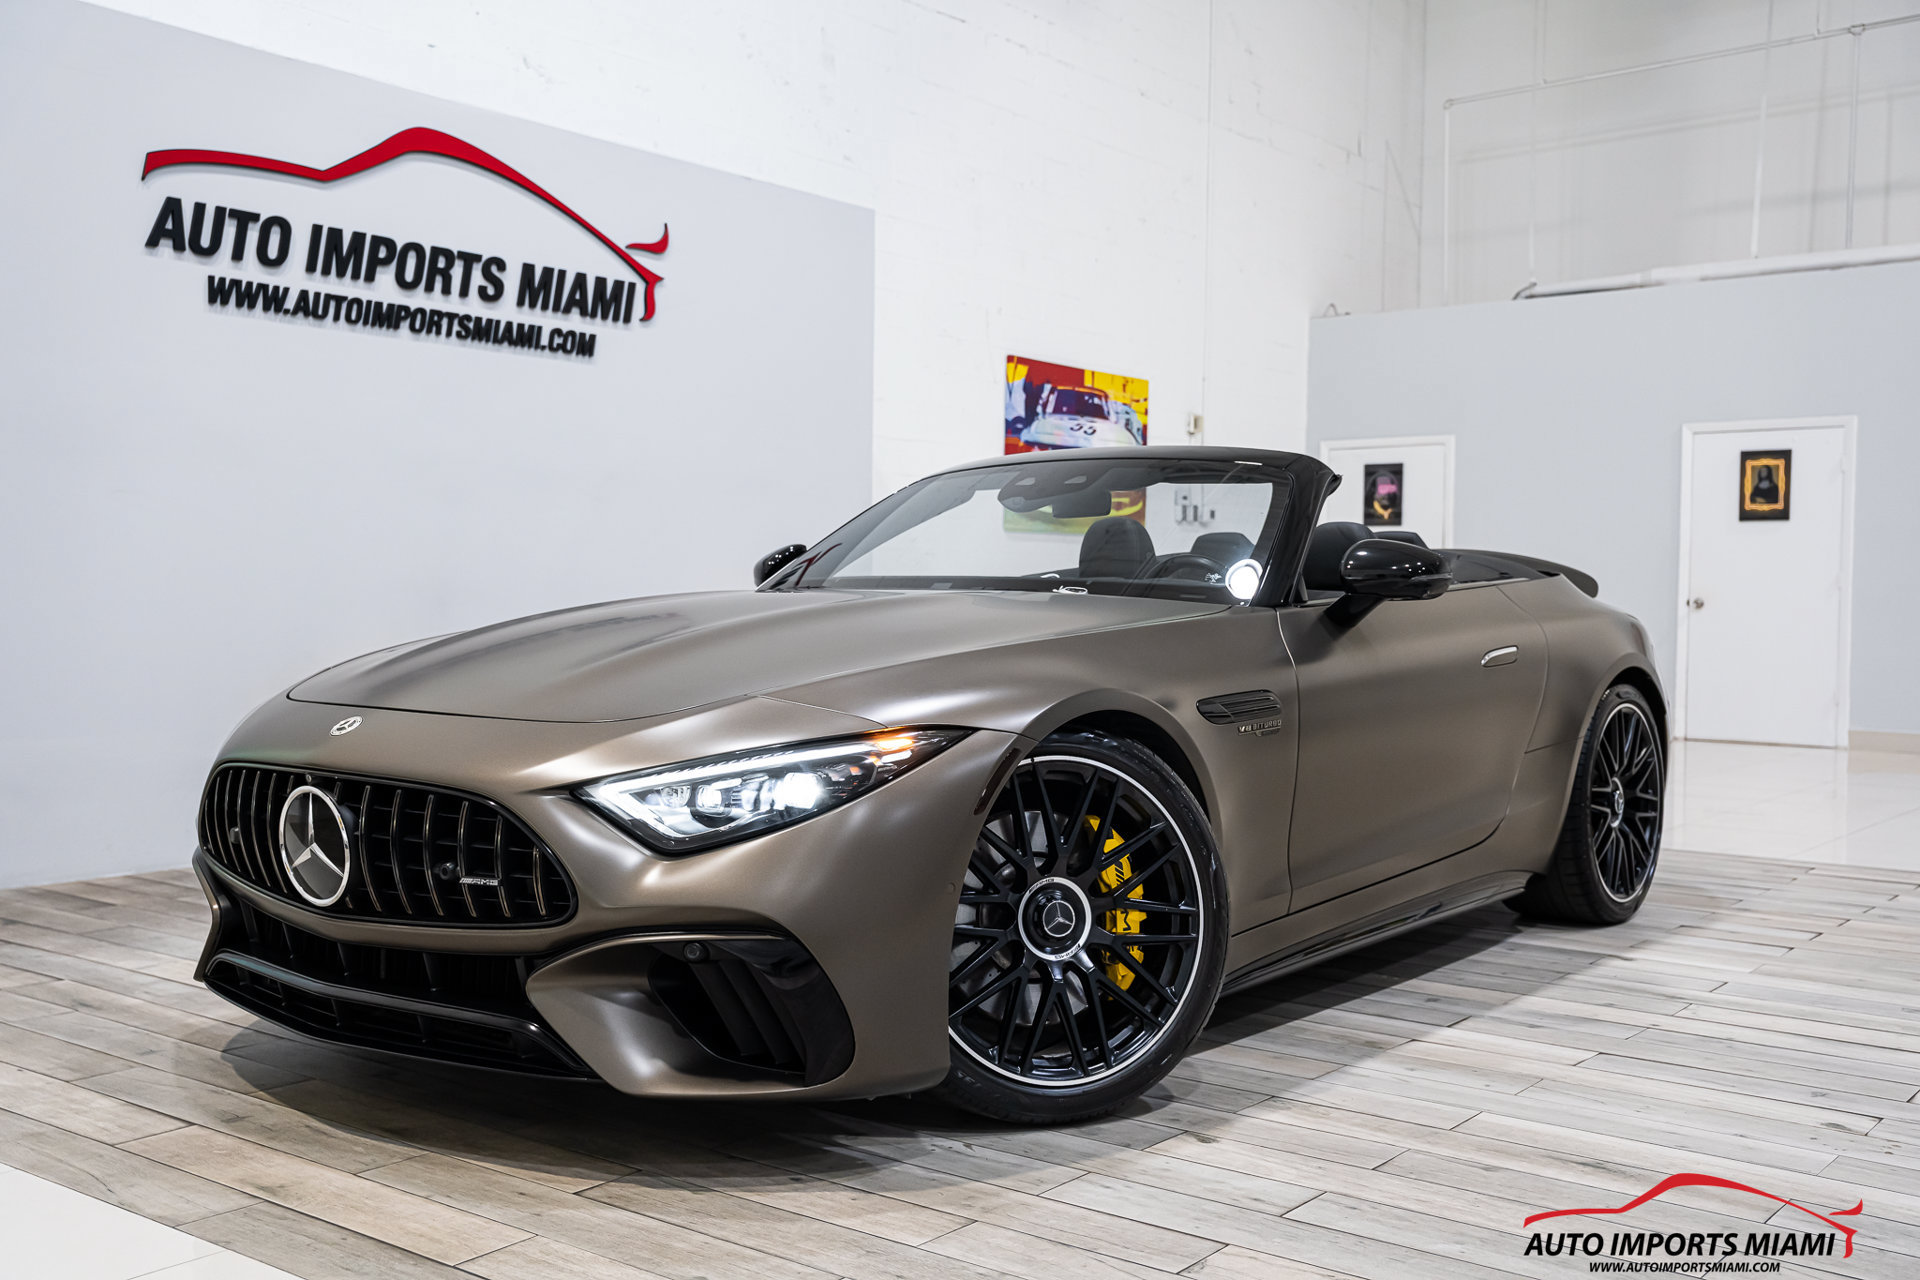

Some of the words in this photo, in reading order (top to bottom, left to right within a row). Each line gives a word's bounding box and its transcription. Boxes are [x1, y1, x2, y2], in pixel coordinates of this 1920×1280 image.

[144, 196, 292, 268] AUTO
[305, 223, 507, 303] IMPORTS
[516, 262, 637, 324] MIAMI
[207, 275, 597, 358] WWW.AUTOIMPORTSMIAMI.COM
